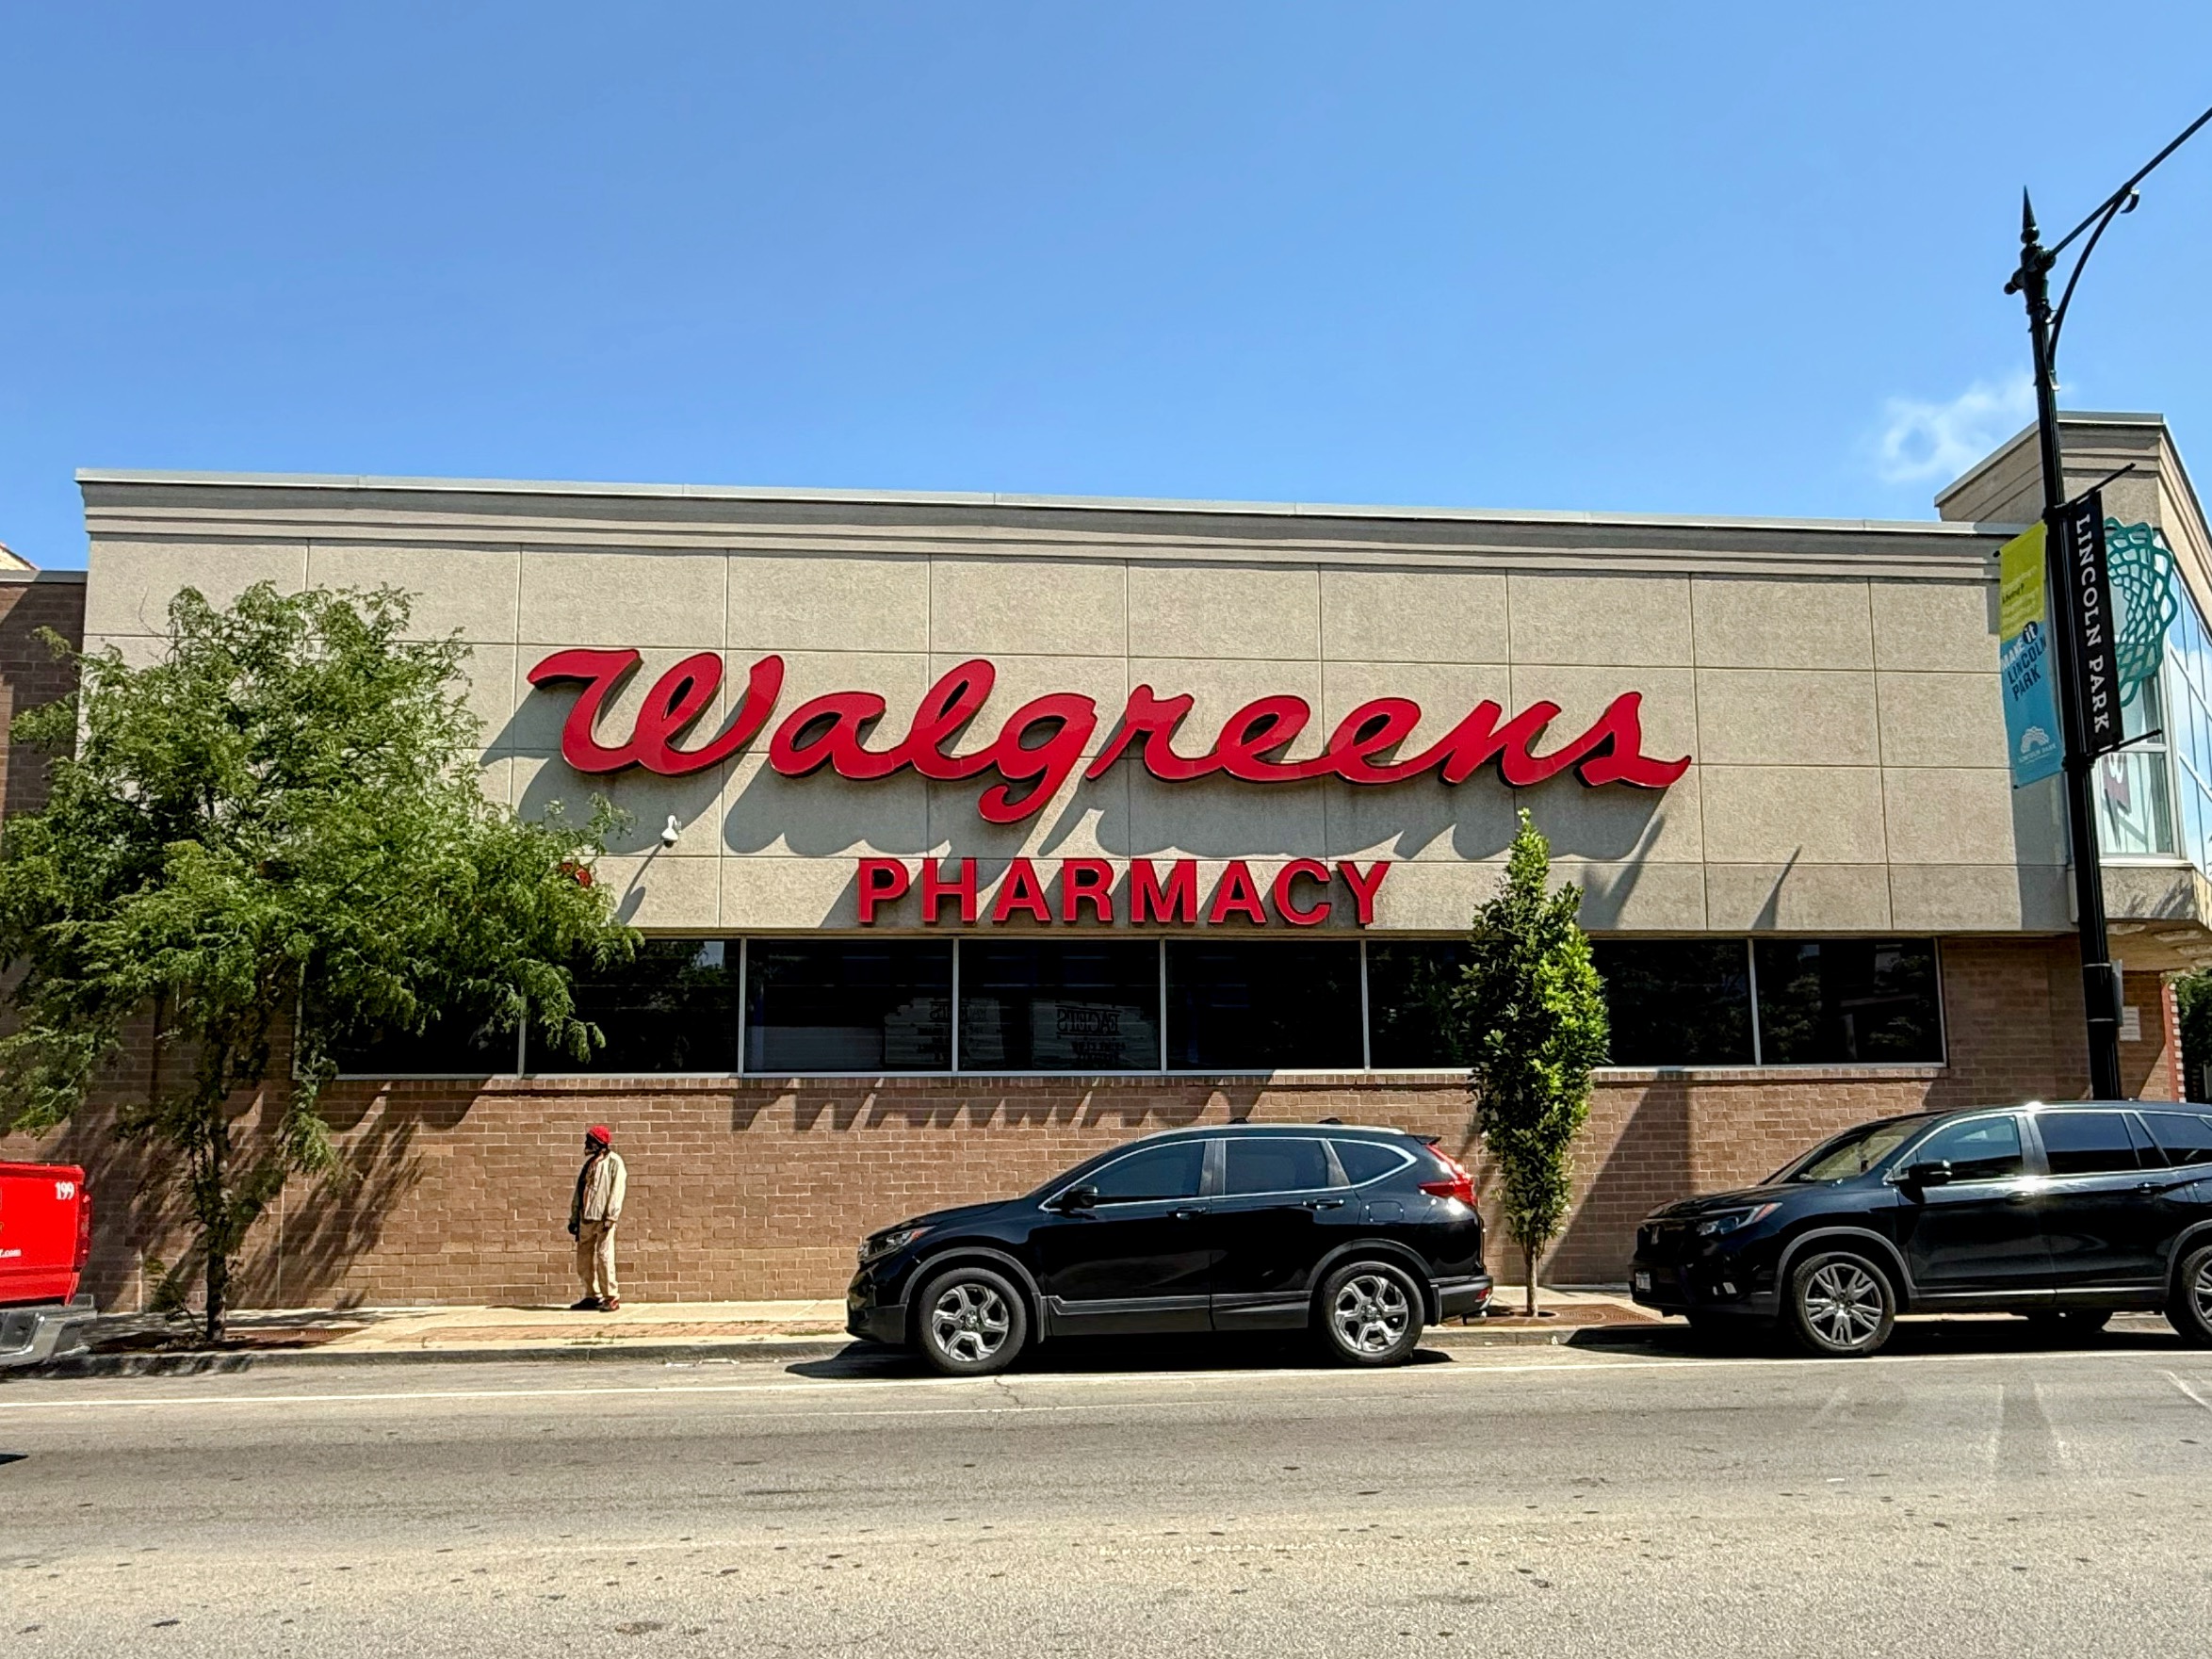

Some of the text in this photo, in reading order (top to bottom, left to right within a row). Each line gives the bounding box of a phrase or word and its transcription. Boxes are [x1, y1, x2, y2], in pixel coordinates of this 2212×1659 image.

[2025, 624, 2037, 643] it
[2076, 513, 2110, 734] LINCOLN PARK
[2008, 636, 2046, 684] LINCOLN
[2011, 664, 2041, 701] PARK
[529, 650, 1691, 823] Walgreens
[858, 858, 1391, 924] PHARMACY
[55, 1181, 74, 1200] 199
